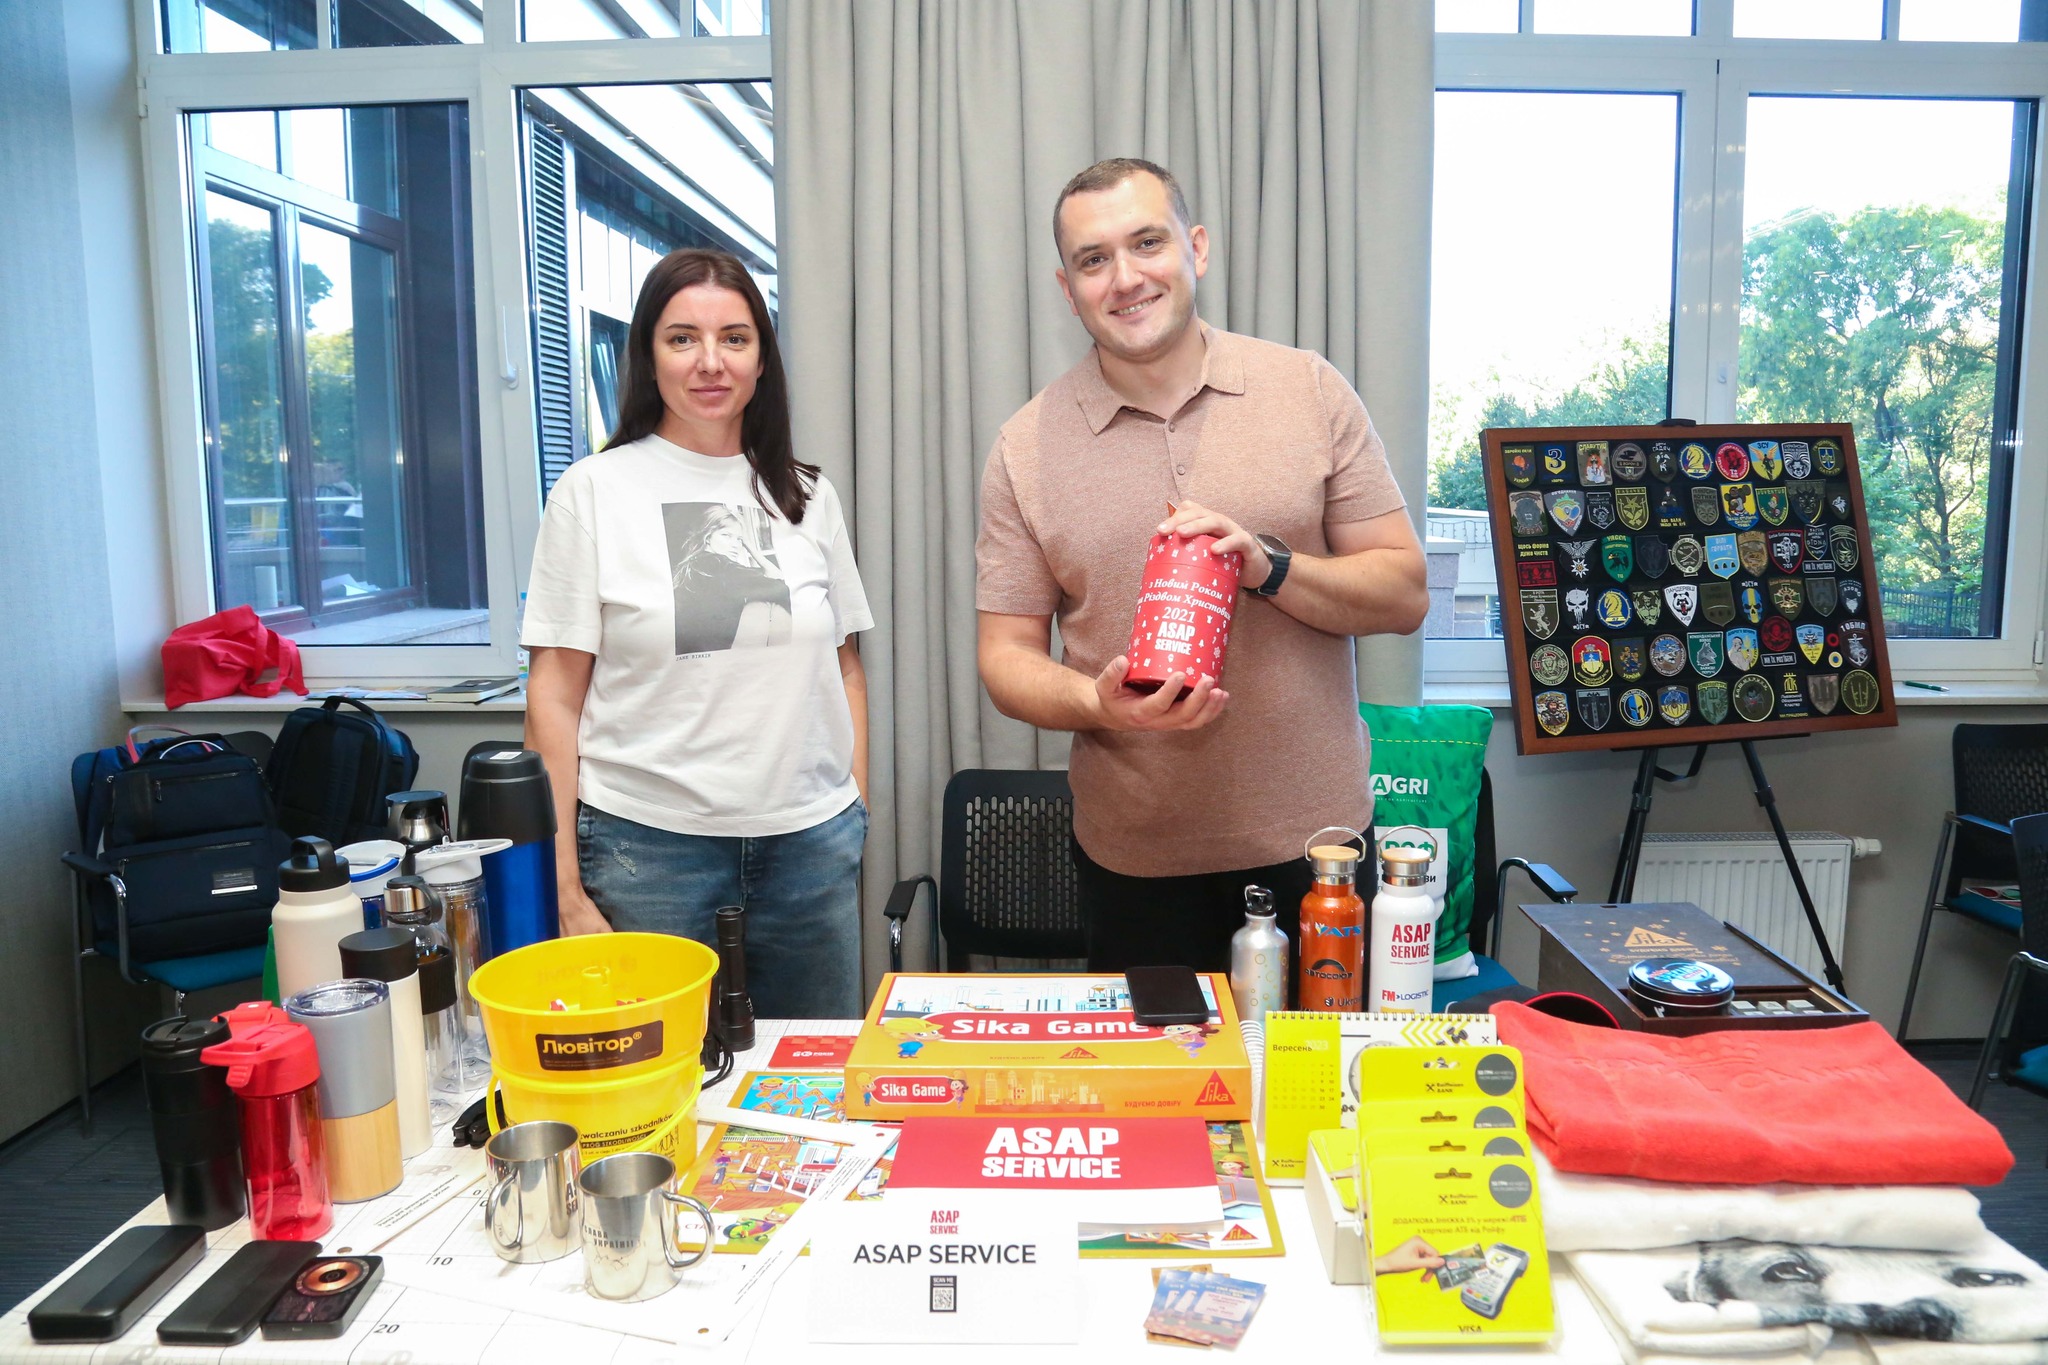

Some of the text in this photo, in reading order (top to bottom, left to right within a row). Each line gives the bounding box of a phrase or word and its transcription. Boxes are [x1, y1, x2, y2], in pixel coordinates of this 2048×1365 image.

[1547, 448, 1563, 469] 3
[1154, 578, 1189, 590] Новим
[1190, 582, 1223, 600] Роком
[1144, 592, 1181, 603] Різдвом
[1162, 606, 1196, 624] 2021
[1157, 621, 1196, 642] ASAP
[1155, 639, 1193, 656] SERVICE
[1391, 922, 1431, 943] ASAP
[1390, 943, 1430, 959] SERVICE
[1381, 989, 1396, 1002] FM
[952, 1018, 1150, 1035] Sika Game
[1272, 1044, 1313, 1052] Вересень
[881, 1083, 946, 1098] Sika Game
[1203, 1080, 1231, 1103] Sika
[580, 1128, 628, 1140] walczaniu
[985, 1127, 1120, 1155] ASAP
[981, 1156, 1122, 1179] SERVICE
[930, 1210, 960, 1223] ASAP
[584, 1224, 609, 1240] СЛАВА
[930, 1225, 959, 1235] SERVICE
[431, 1256, 453, 1266] 10
[853, 1244, 1037, 1265] ASAP SERVICE
[373, 1323, 400, 1335] 20
